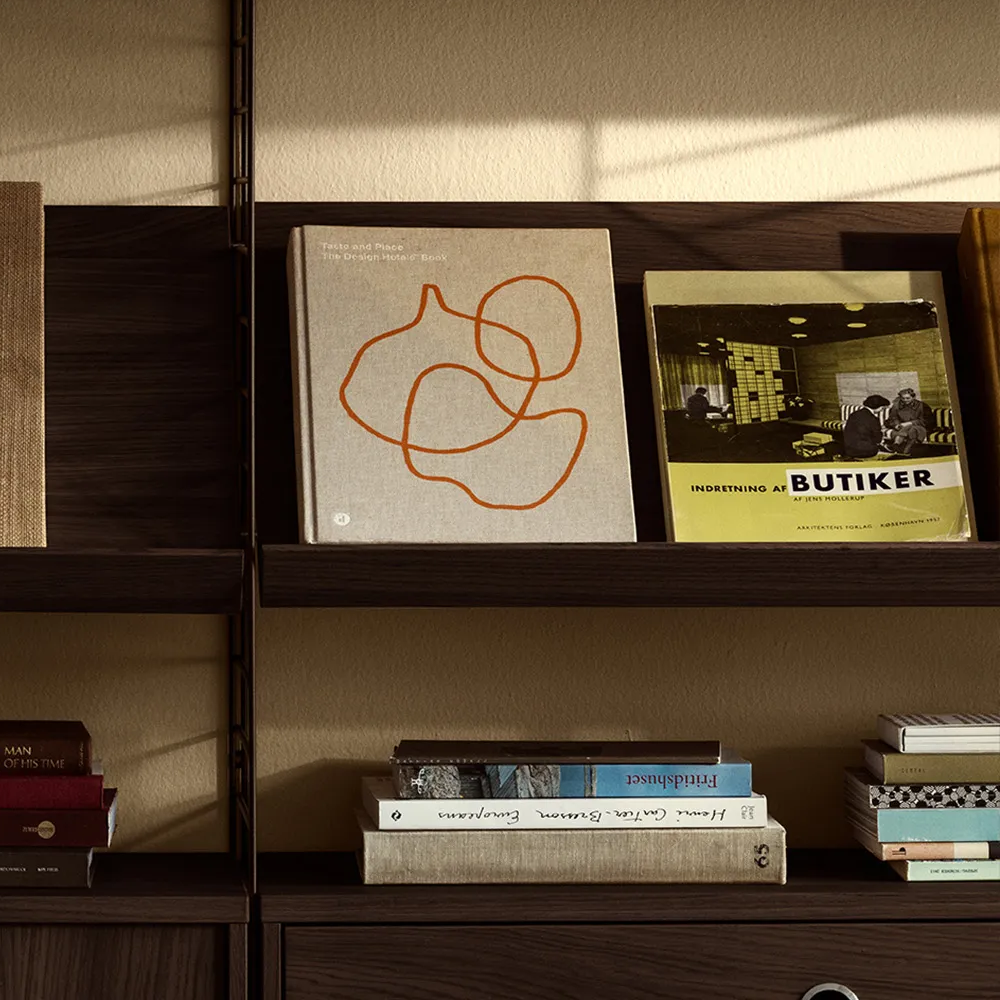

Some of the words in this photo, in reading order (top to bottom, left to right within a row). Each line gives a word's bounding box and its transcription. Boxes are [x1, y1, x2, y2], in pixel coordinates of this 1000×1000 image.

[352, 242, 371, 251] and
[344, 253, 379, 261] Design
[421, 253, 448, 261] Book
[691, 485, 767, 493] INDRETNING
[773, 484, 788, 493] AF
[791, 469, 935, 493] BUTIKER
[4, 746, 32, 756] MAN
[4, 758, 19, 769] OF
[20, 758, 39, 769] HIS
[41, 758, 65, 769] TIME
[626, 774, 718, 788] Fritidshuset
[438, 806, 519, 825] Europeans
[676, 808, 727, 822] Henri
